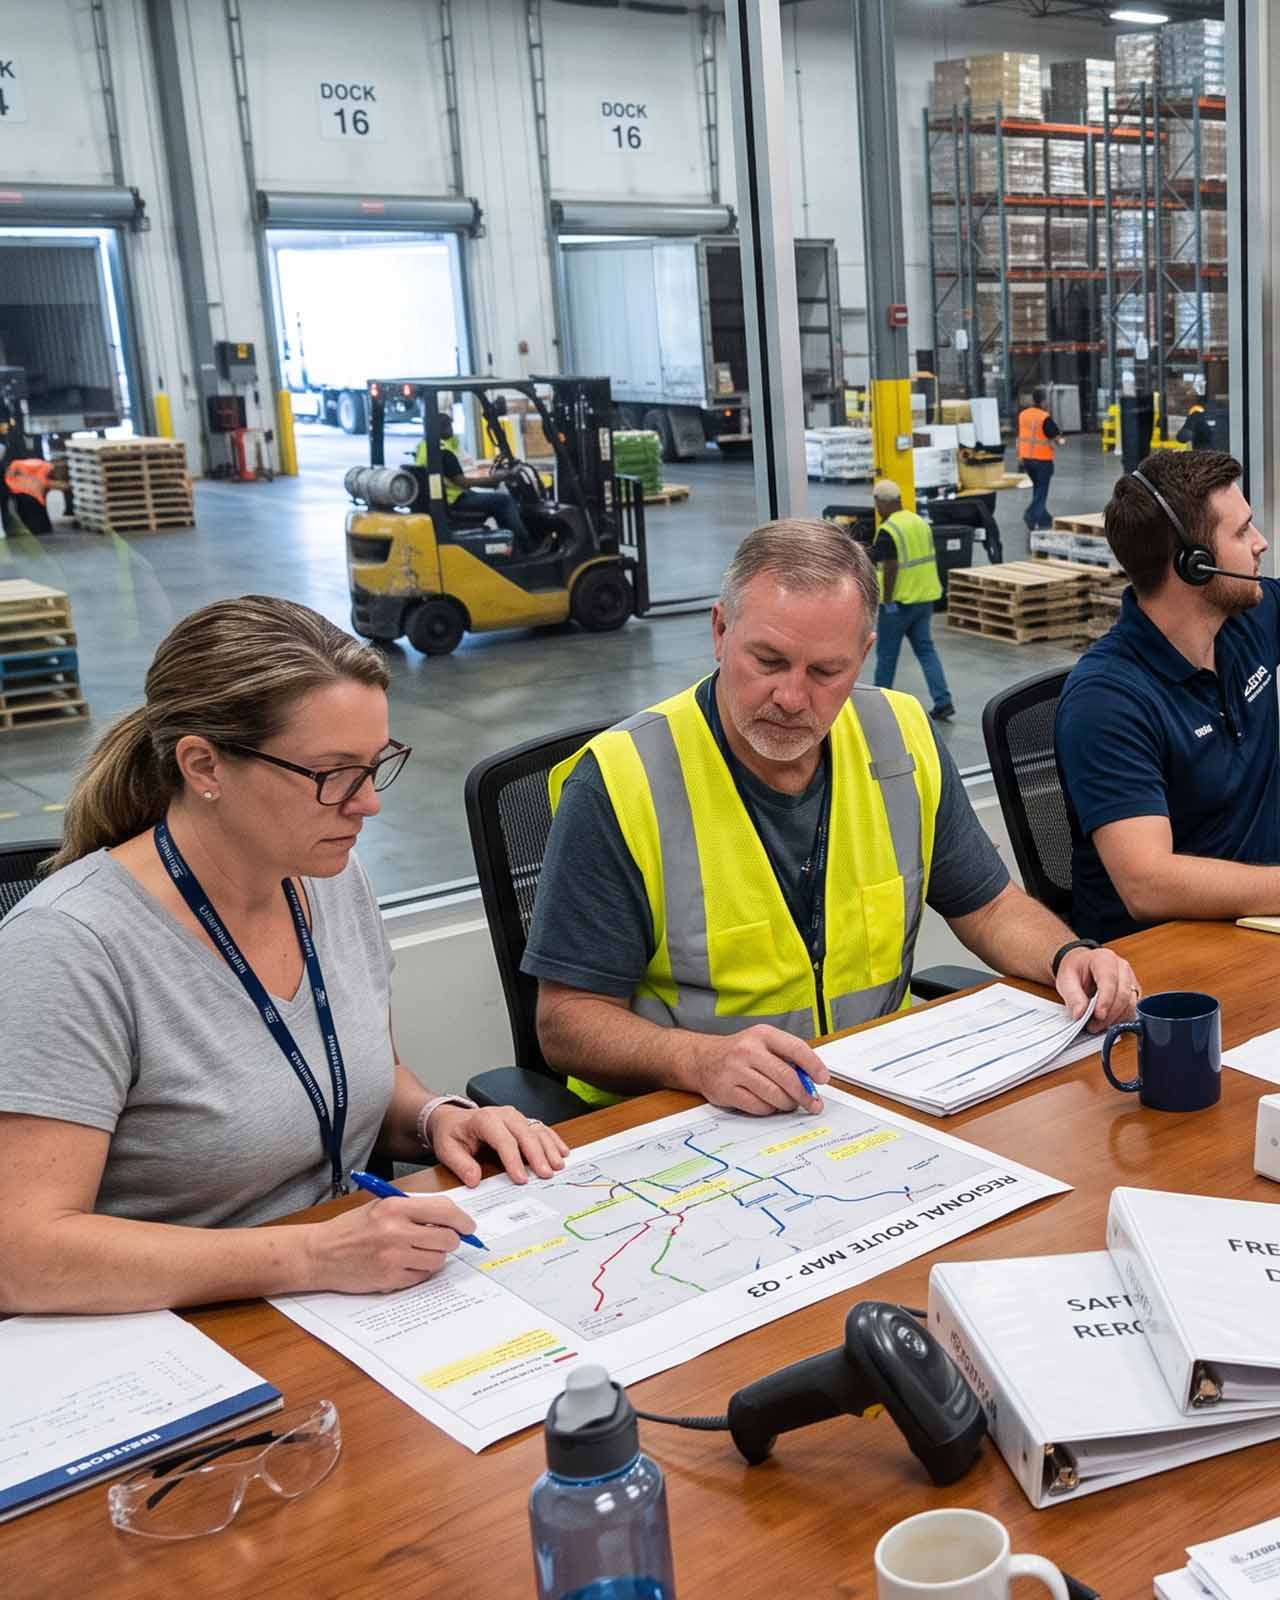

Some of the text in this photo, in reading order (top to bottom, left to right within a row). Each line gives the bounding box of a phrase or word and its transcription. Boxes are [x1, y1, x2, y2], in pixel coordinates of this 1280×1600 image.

[320, 82, 376, 102] DOCK
[333, 108, 370, 136] 16
[601, 100, 648, 119] DOCK
[612, 125, 642, 150] 16
[919, 1175, 1019, 1221] REGIONAL
[847, 1218, 919, 1255] ROUTE
[799, 1250, 847, 1278] MAP
[747, 1278, 781, 1299] Q3
